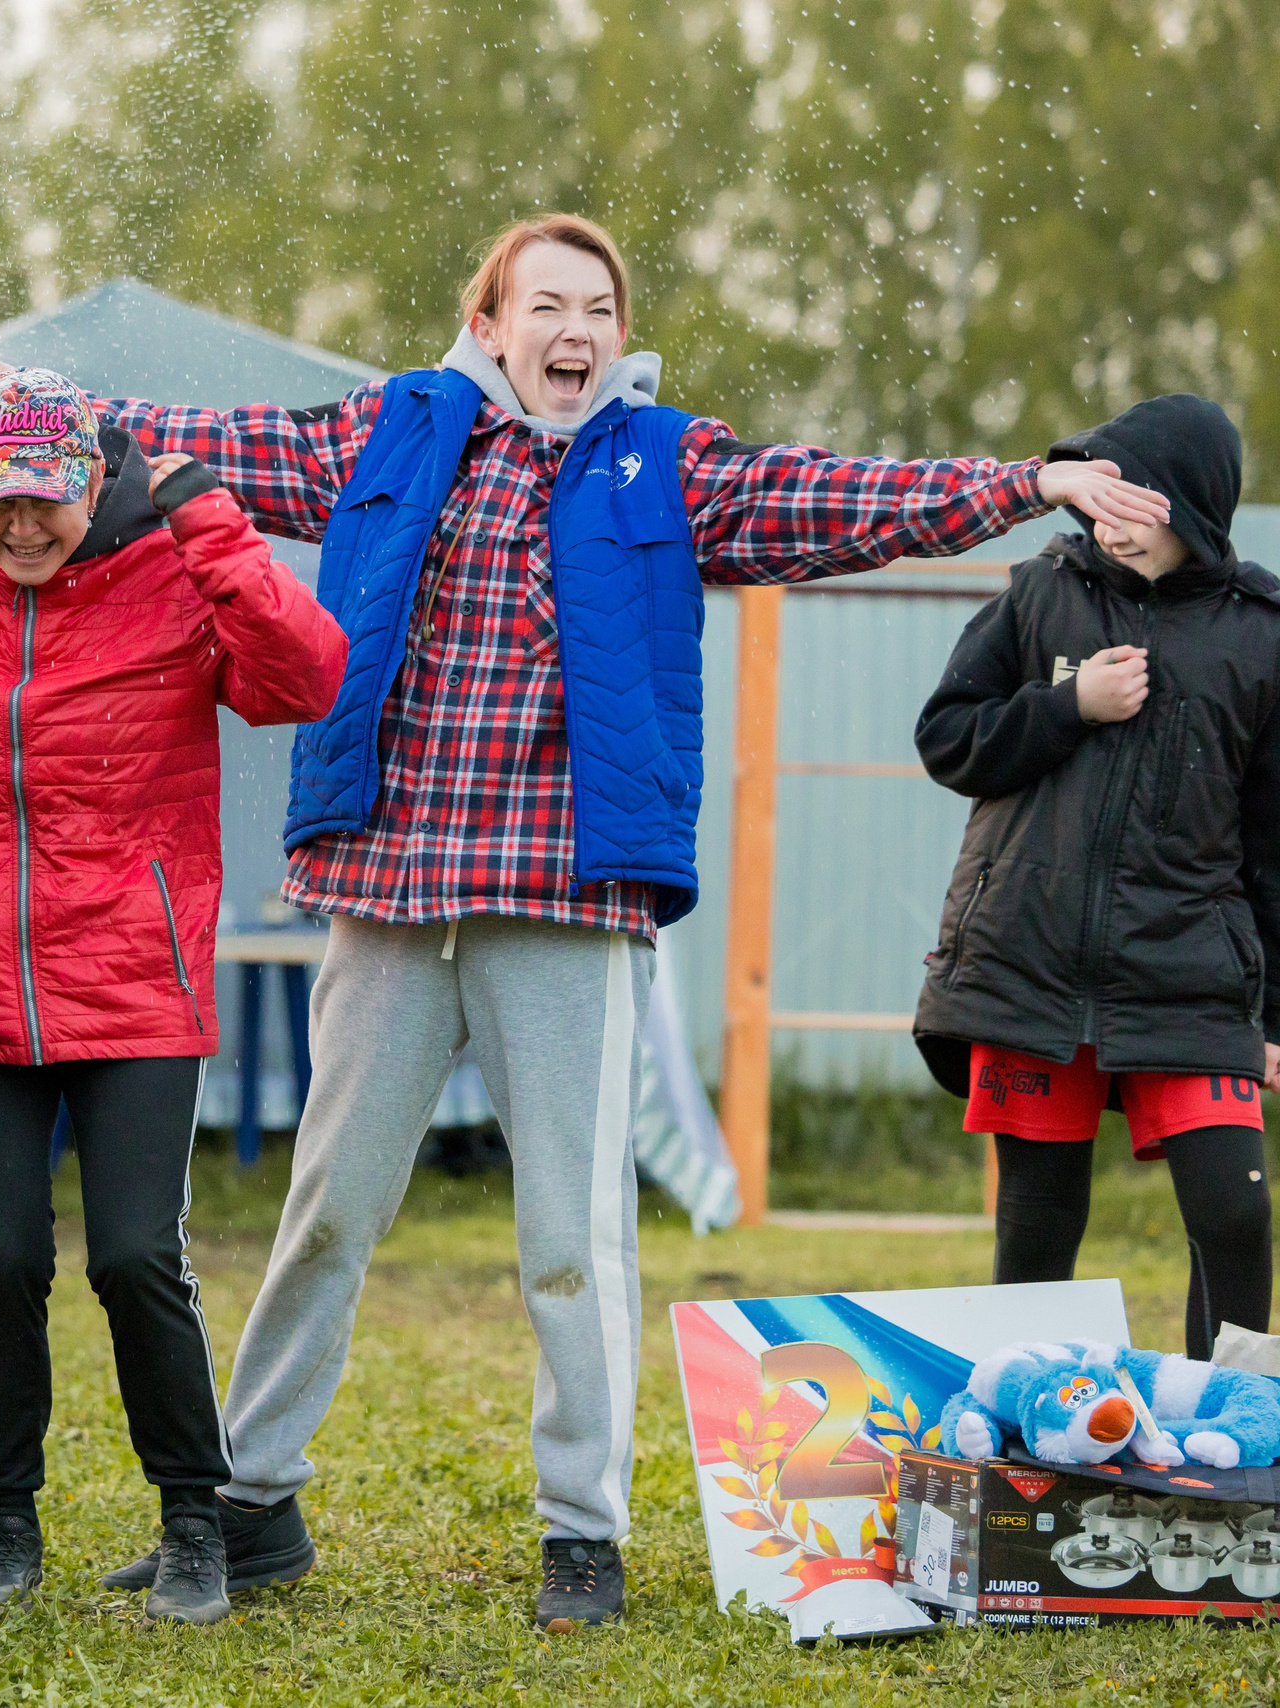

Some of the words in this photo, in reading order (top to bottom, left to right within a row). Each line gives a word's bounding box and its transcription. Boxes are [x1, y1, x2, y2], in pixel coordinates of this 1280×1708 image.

[760, 1341, 890, 1501] 2
[1007, 1470, 1057, 1478] MERCURY
[990, 1516, 1027, 1526] 12PCS
[984, 1579, 1040, 1593] JUMBO
[1050, 1615, 1064, 1626] (12
[1065, 1616, 1099, 1626] PIECES
